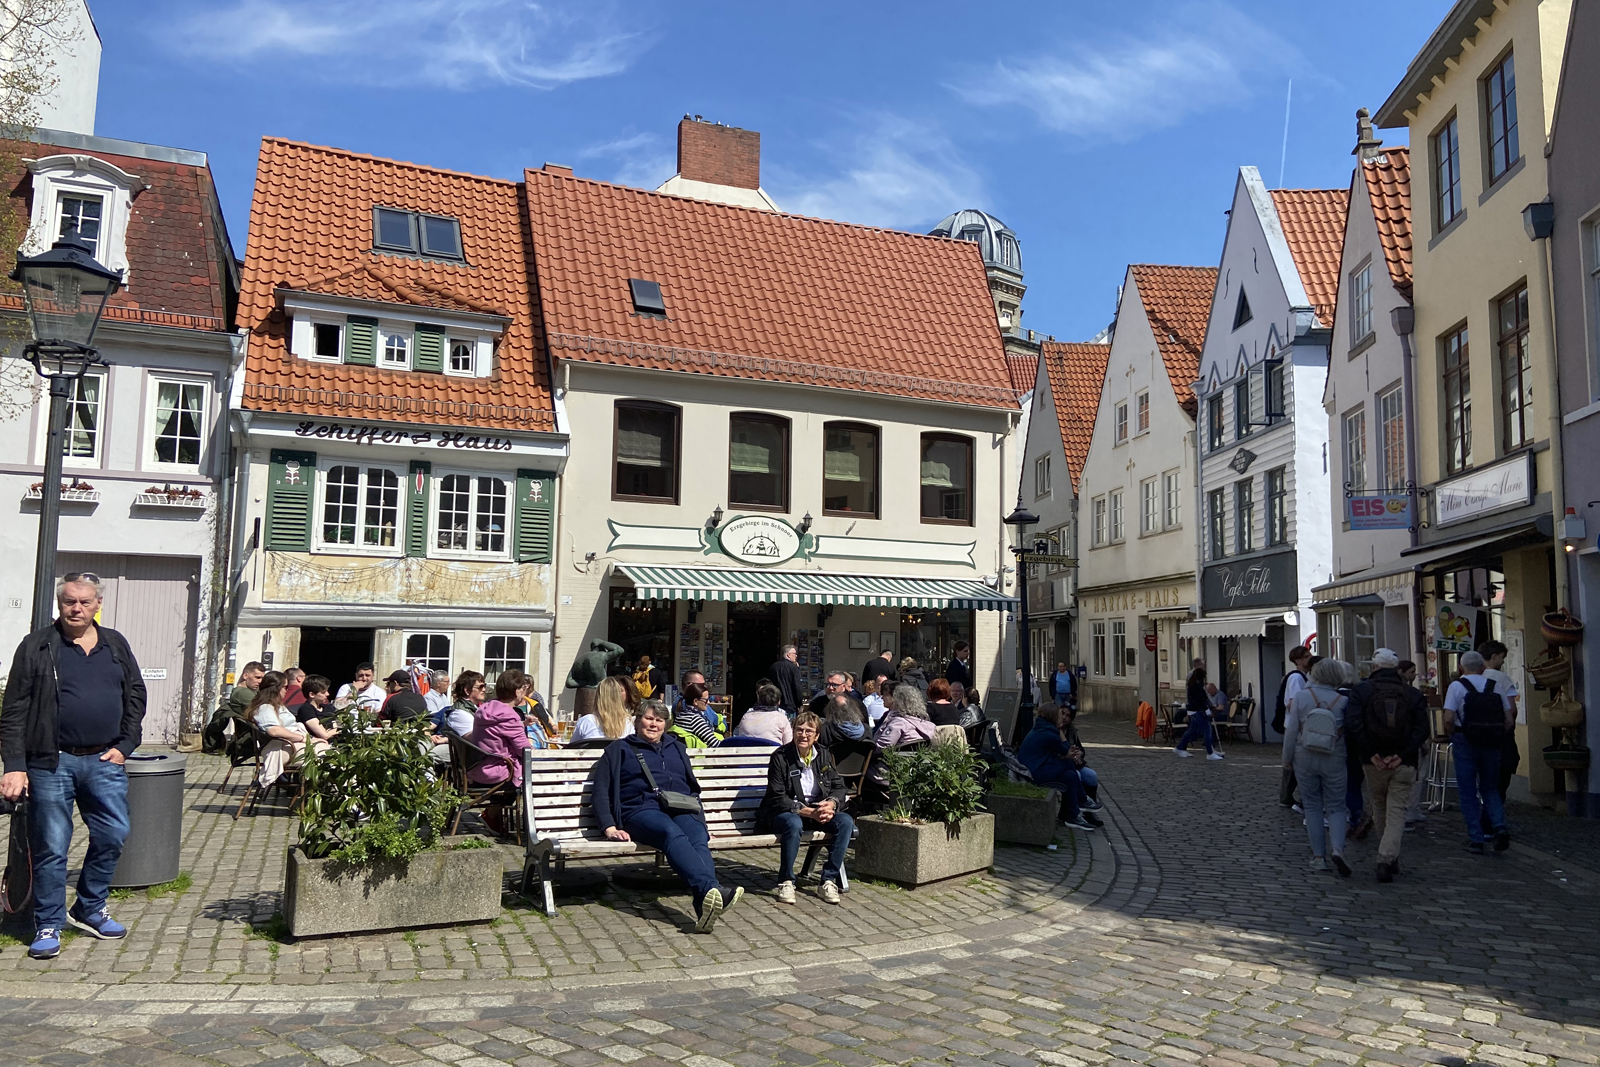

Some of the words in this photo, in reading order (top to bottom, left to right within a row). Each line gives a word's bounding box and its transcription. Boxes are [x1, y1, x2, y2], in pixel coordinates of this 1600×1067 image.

[1491, 470, 1523, 497] Mario
[1351, 498, 1385, 516] EIS
[729, 520, 760, 533] Erzgebirge
[1436, 640, 1471, 651] EIS
